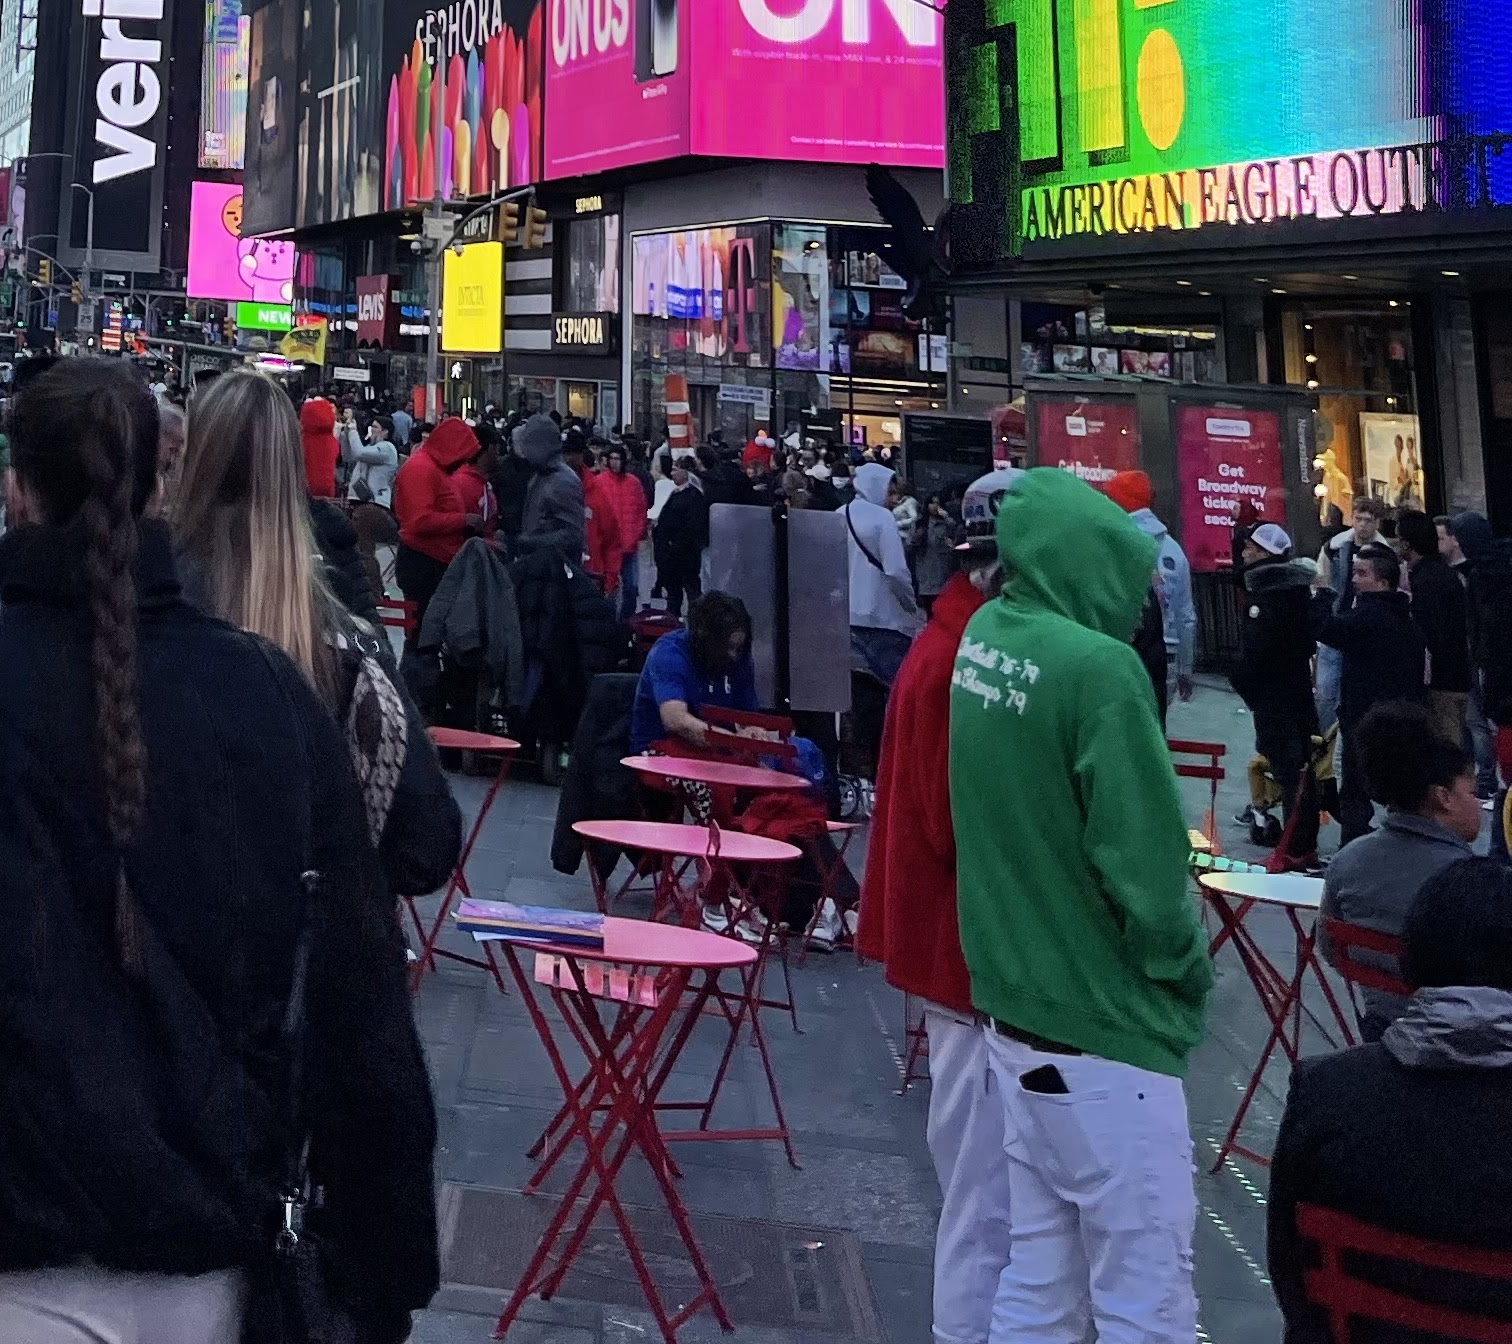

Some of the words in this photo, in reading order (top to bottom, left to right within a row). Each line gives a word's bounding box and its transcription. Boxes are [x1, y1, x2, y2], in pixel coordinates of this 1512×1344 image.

[1025, 169, 1186, 239] AMERICAN
[1197, 156, 1318, 226] EAGLE
[555, 317, 604, 345] SEPHORA
[1217, 463, 1245, 478] Get
[1197, 478, 1267, 498] Broadway
[1202, 495, 1241, 511] ticke
